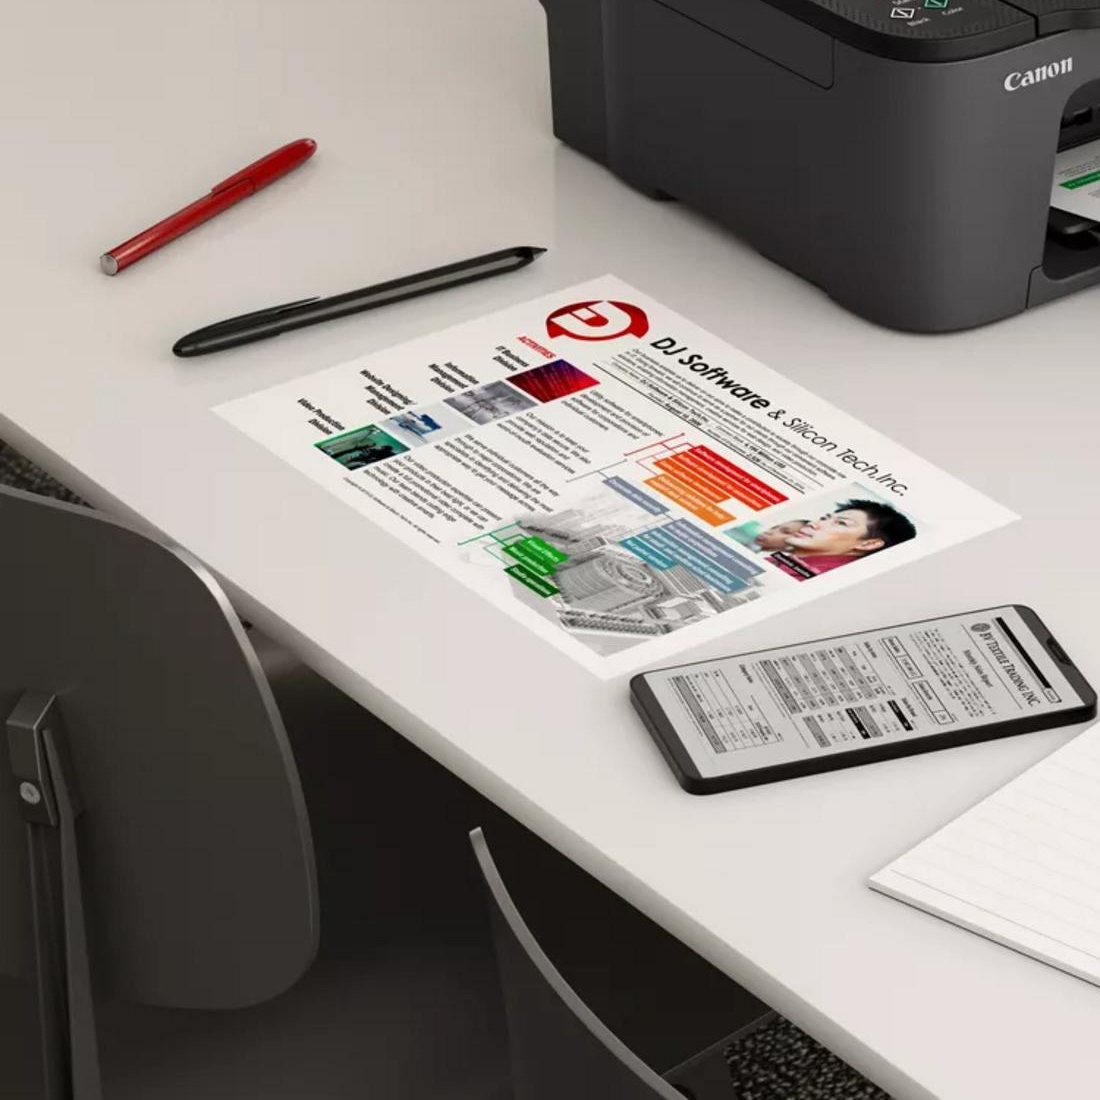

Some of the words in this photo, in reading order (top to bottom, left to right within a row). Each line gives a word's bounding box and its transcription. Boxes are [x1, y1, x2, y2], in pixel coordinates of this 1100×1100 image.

[1003, 56, 1074, 92] Canon
[501, 349, 530, 368] Business
[517, 336, 556, 359] ACTIVITIES
[444, 362, 480, 385] Information
[492, 355, 518, 372] Division
[359, 369, 385, 386] Website
[428, 363, 469, 389] Management
[430, 376, 455, 393] Division
[364, 384, 405, 411] Management
[649, 337, 688, 356] DJ
[678, 354, 771, 409] Software
[767, 409, 786, 421] &
[782, 417, 838, 452] Silicon
[297, 398, 316, 411] Video
[312, 408, 346, 431] Production
[366, 398, 391, 415] Division
[307, 418, 333, 436] Division
